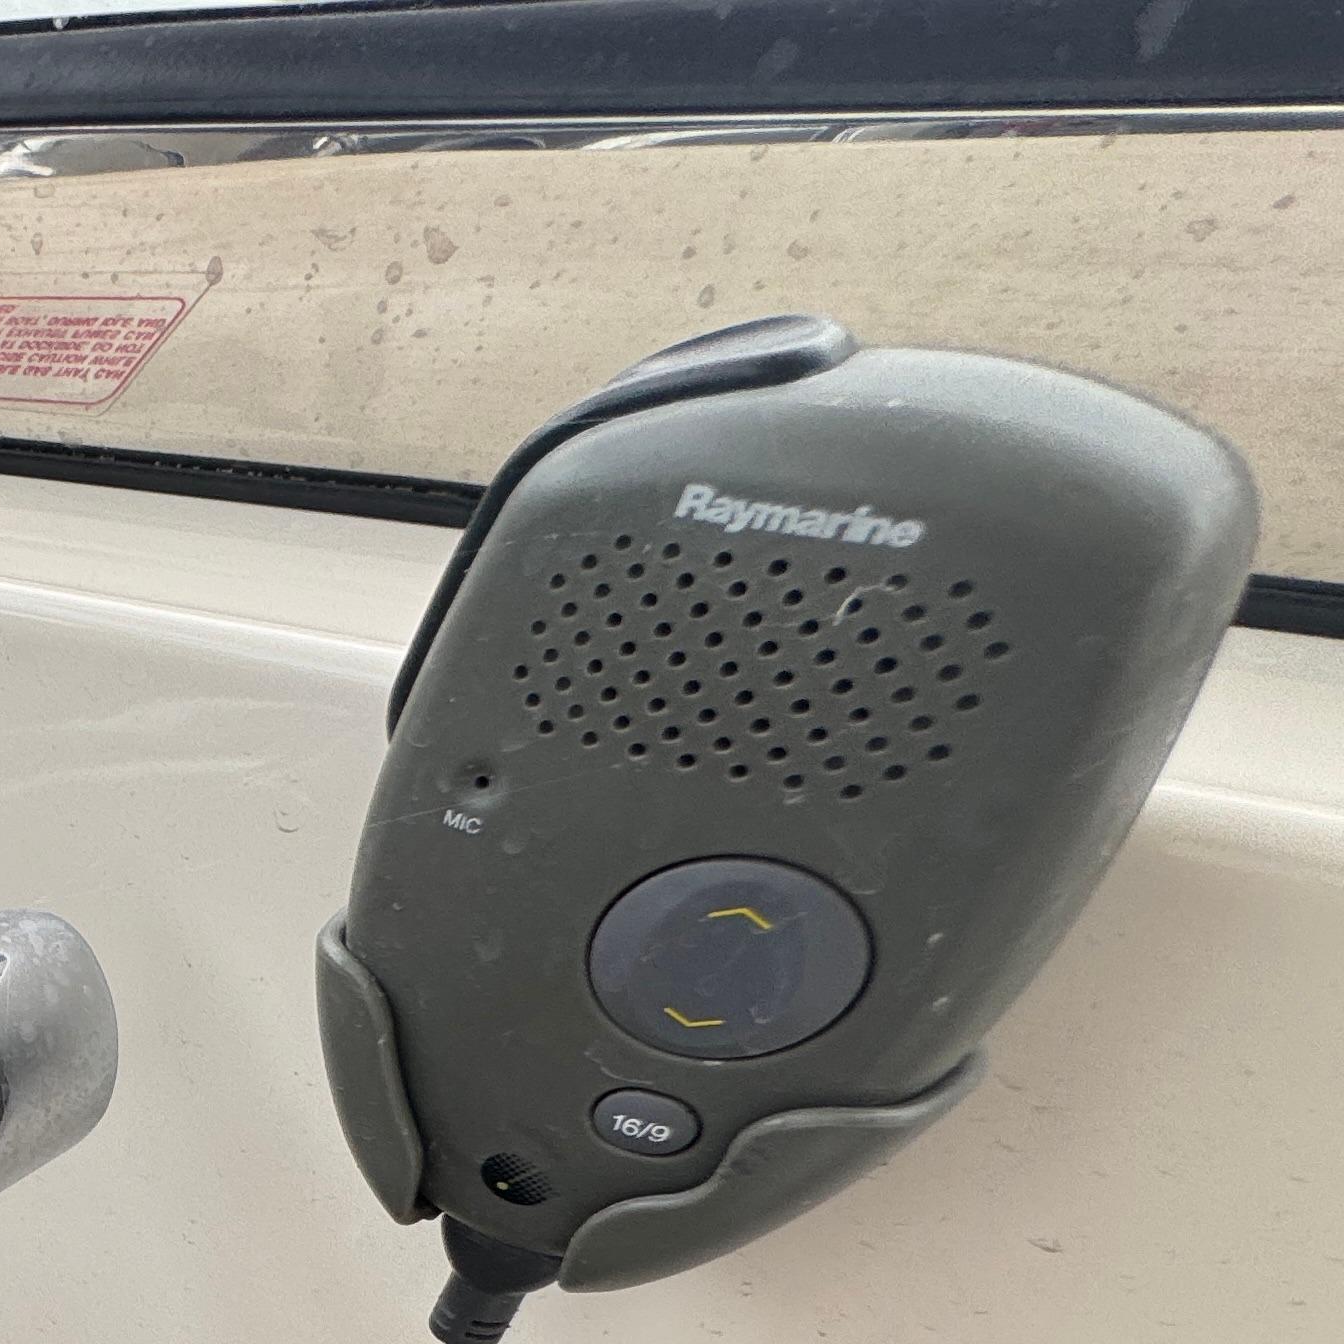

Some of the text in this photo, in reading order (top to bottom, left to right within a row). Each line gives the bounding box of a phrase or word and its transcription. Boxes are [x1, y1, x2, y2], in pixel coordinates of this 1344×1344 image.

[674, 483, 926, 549] Raymarine
[442, 809, 483, 836] MIC
[611, 1113, 672, 1145] 16/9
